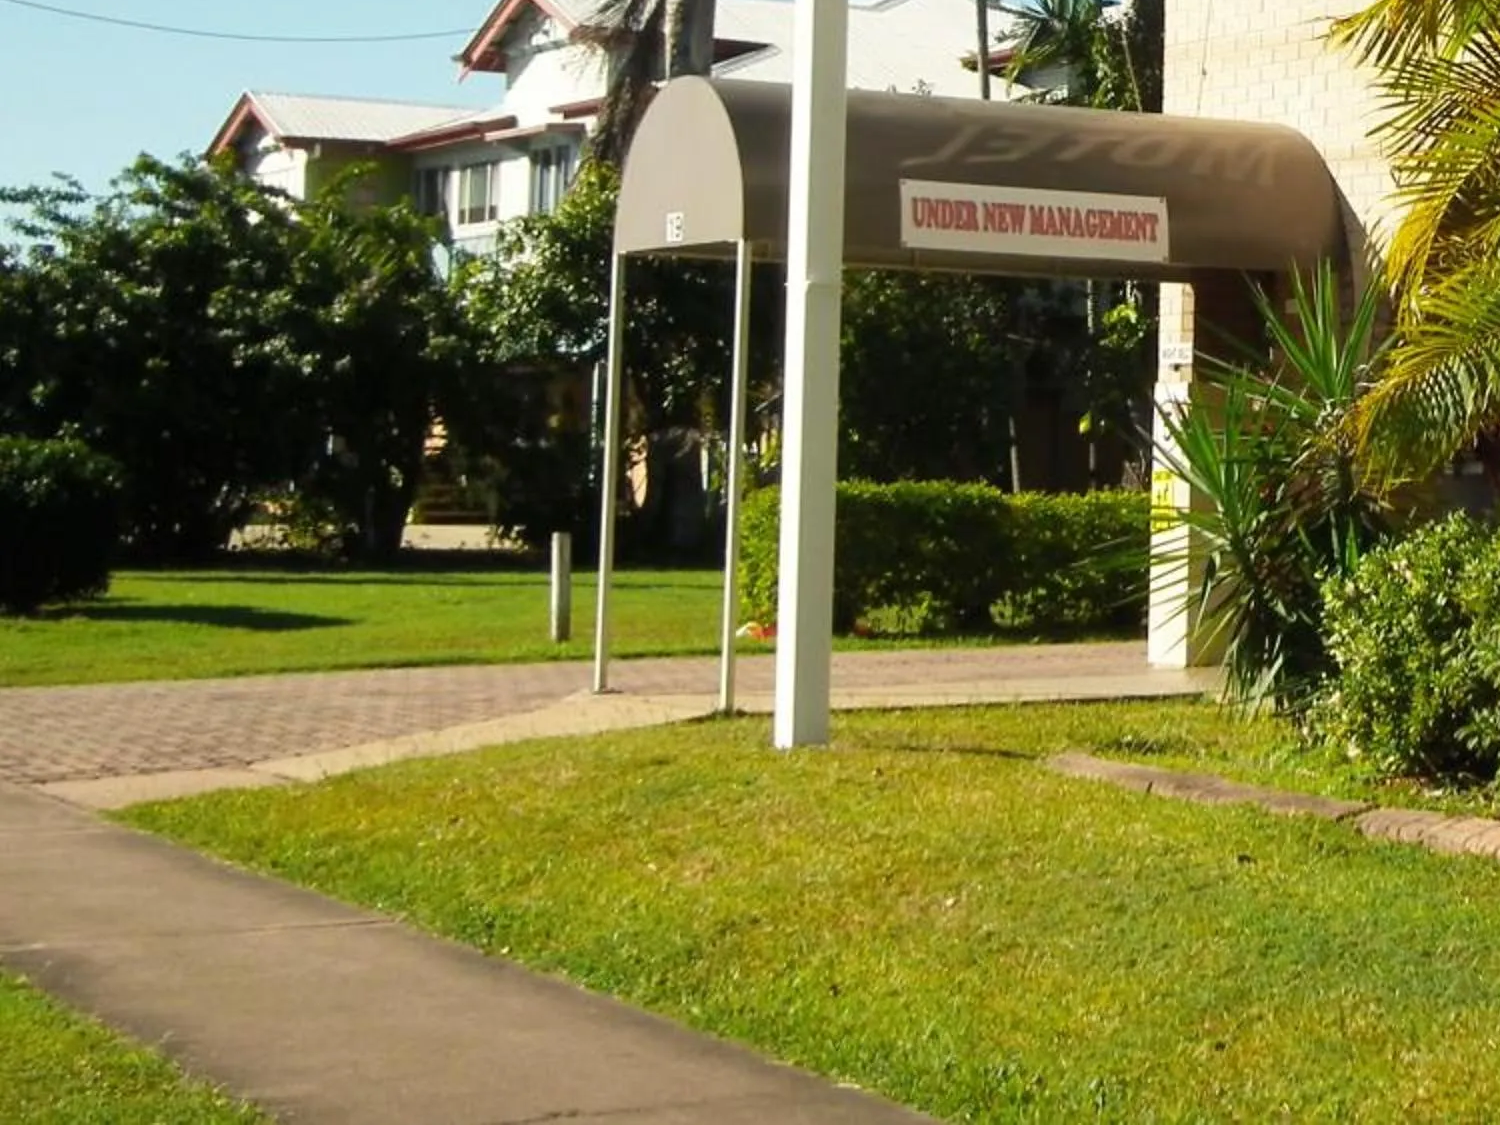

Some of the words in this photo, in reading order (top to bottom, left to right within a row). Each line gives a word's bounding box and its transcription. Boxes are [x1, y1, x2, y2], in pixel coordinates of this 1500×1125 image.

[911, 197, 980, 233] UNDER
[982, 200, 1026, 236] NEW
[1029, 204, 1159, 243] MANAGEMENT
